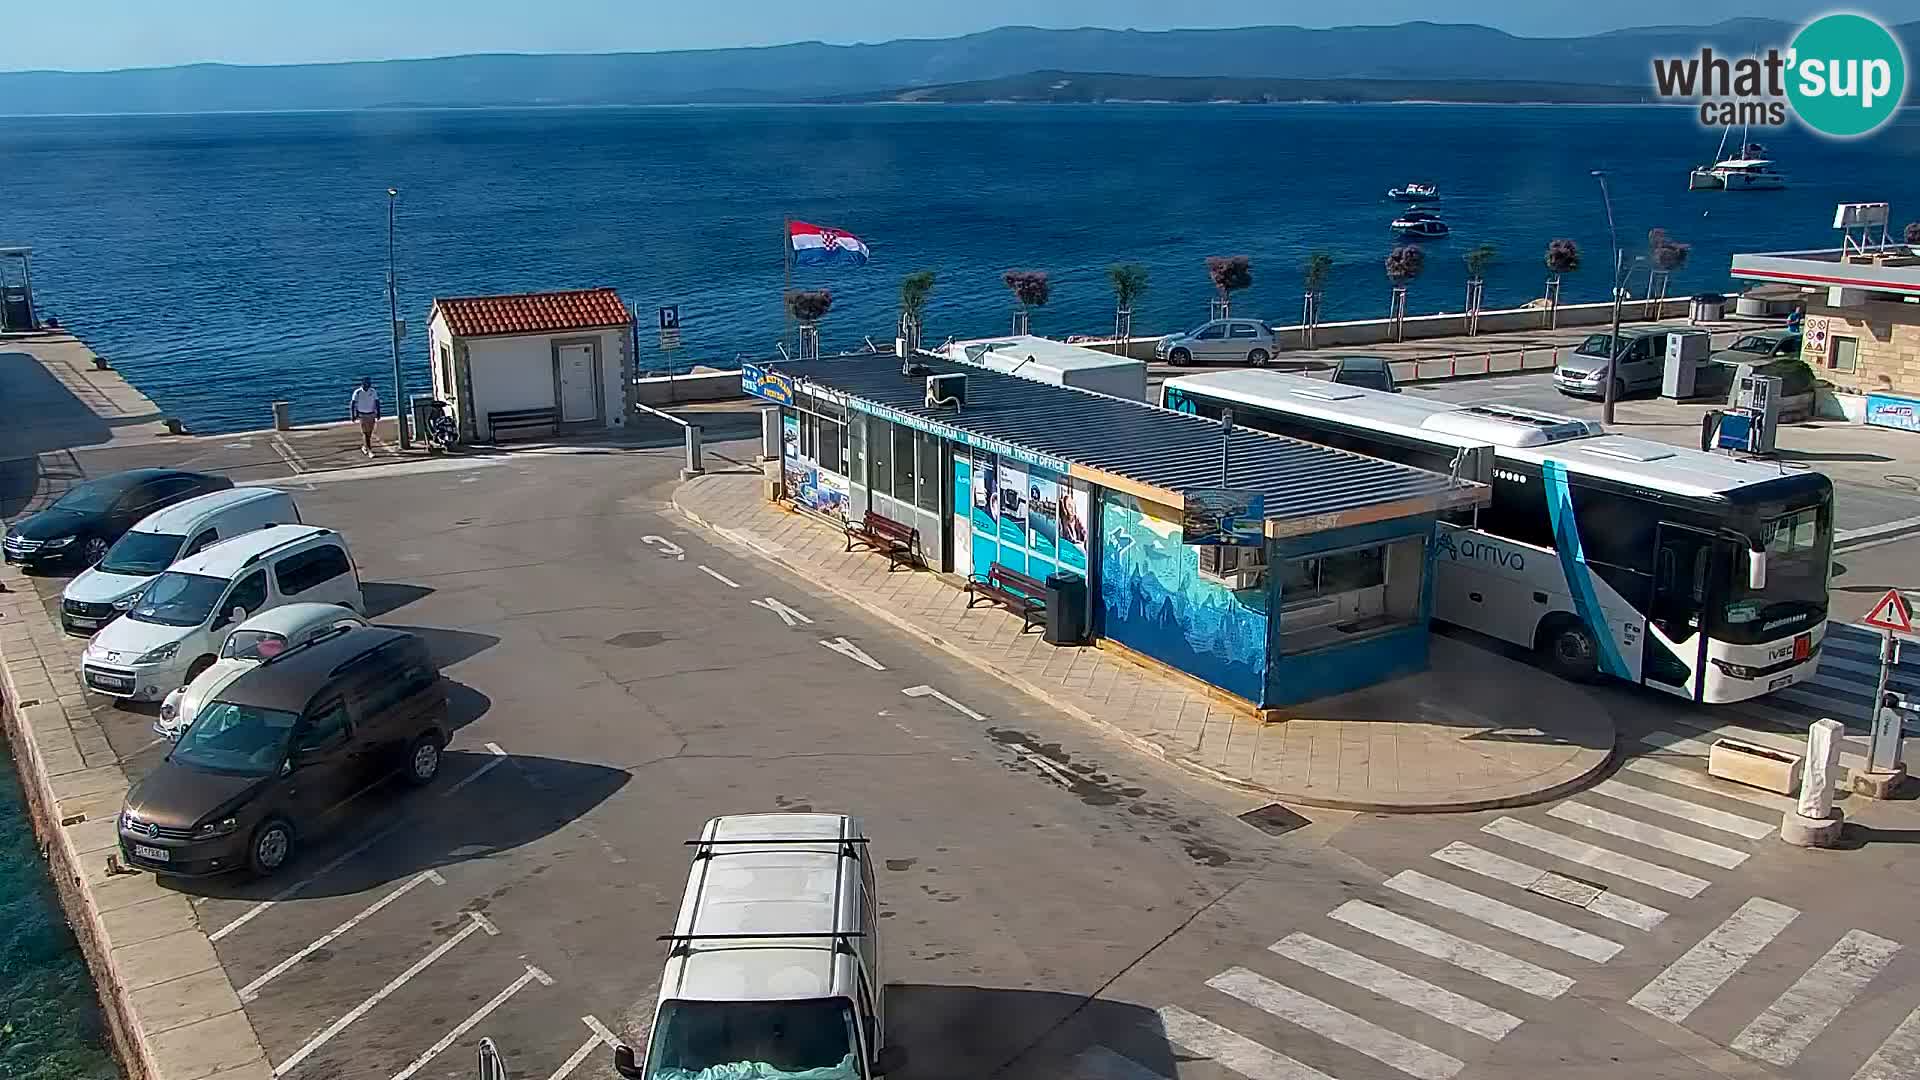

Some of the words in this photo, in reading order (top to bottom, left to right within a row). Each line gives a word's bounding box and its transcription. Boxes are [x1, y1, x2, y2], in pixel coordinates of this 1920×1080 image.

[663, 309, 674, 326] P
[893, 411, 928, 430] AUTOBUSNA
[929, 423, 958, 440] POSTAJA
[980, 440, 1012, 456] STATION
[1014, 449, 1038, 464] TICKET
[1039, 456, 1065, 472] OFFICE
[1461, 540, 1524, 570] arriva
